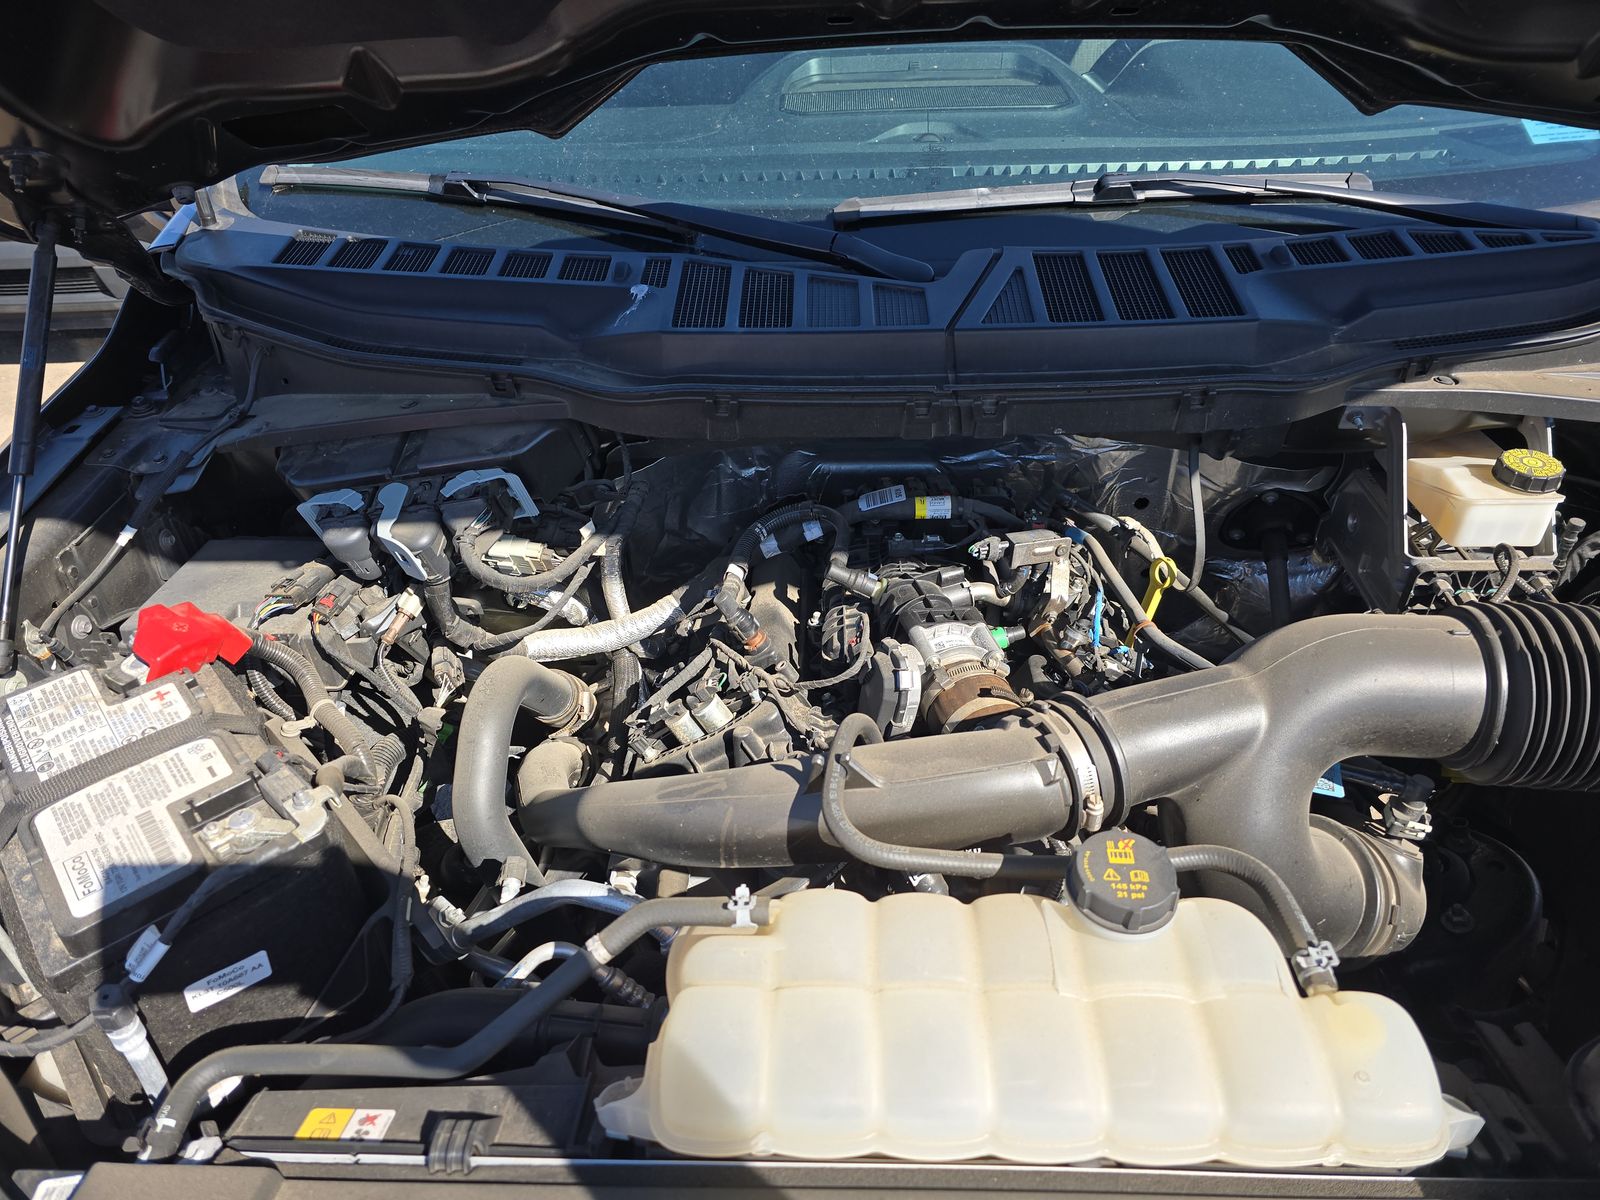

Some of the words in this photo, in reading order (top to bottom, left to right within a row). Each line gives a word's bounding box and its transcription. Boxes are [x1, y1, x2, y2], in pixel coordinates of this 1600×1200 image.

[72, 855, 97, 896] FoMoCo
[1116, 890, 1128, 898] 21
[206, 965, 245, 985] FoMoCo
